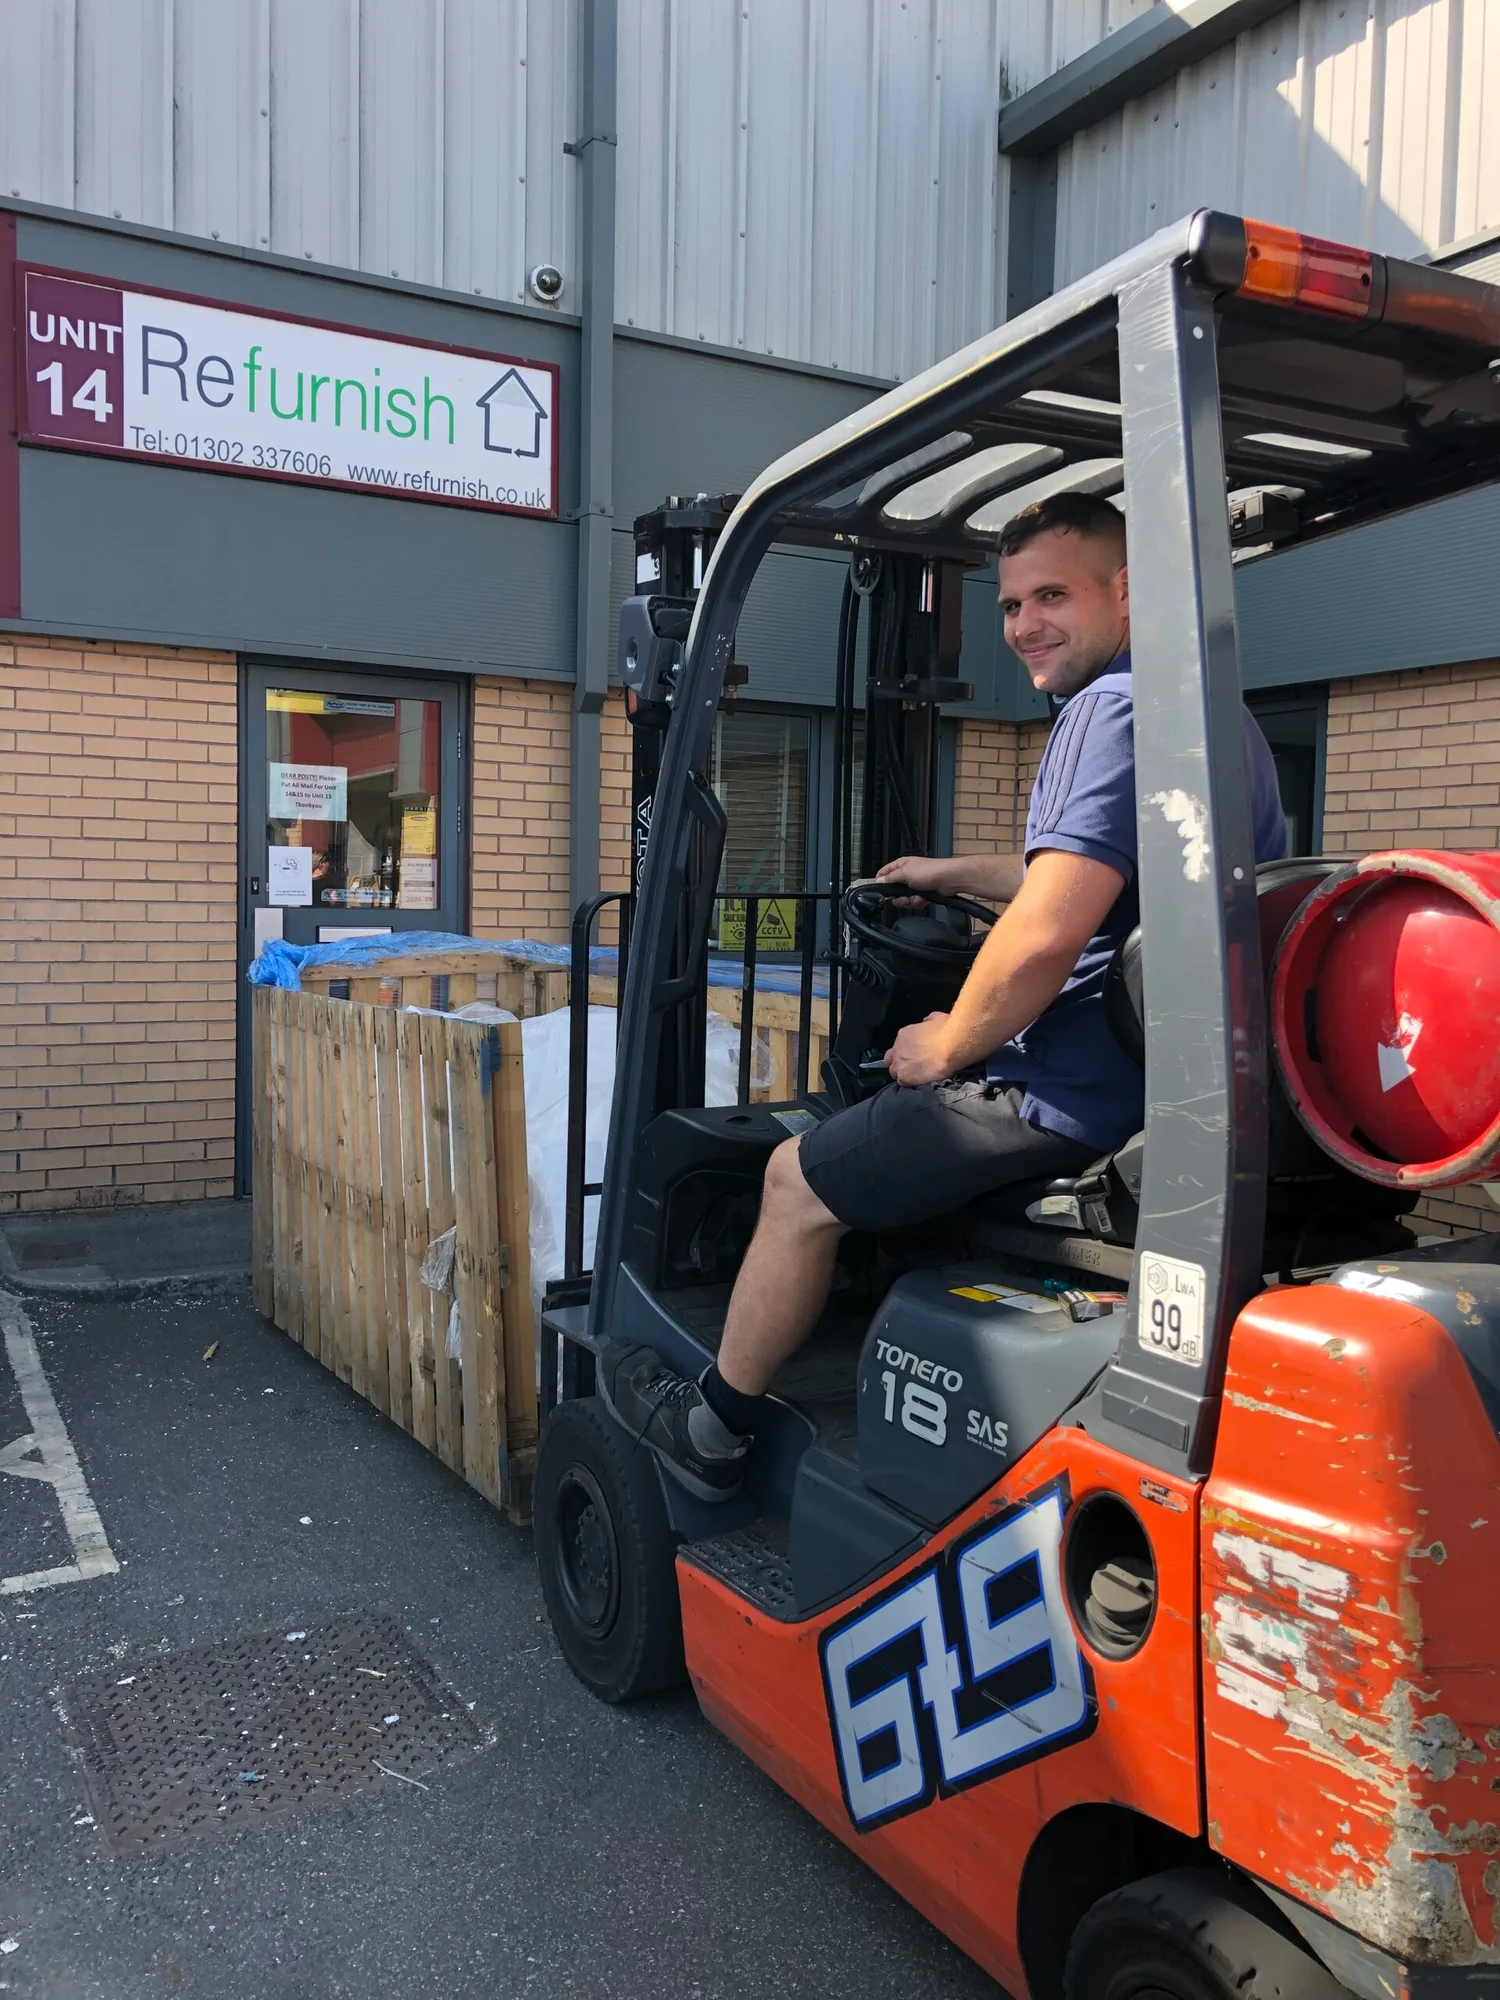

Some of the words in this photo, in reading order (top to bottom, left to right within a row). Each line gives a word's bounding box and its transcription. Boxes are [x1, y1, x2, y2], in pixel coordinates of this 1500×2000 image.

[28, 310, 123, 354] UNIT
[36, 361, 114, 423] 14
[141, 324, 455, 445] Refurnish
[251, 445, 332, 476] 337606
[347, 463, 547, 508] www.refurnish.co.uk
[318, 774, 337, 782] Please
[295, 801, 322, 809] Thankyou
[761, 926, 784, 935] CCTV
[1151, 1298, 1182, 1351] 99
[1181, 1341, 1197, 1357] dB
[881, 1370, 948, 1446] 18
[966, 1409, 1009, 1448] SAS
